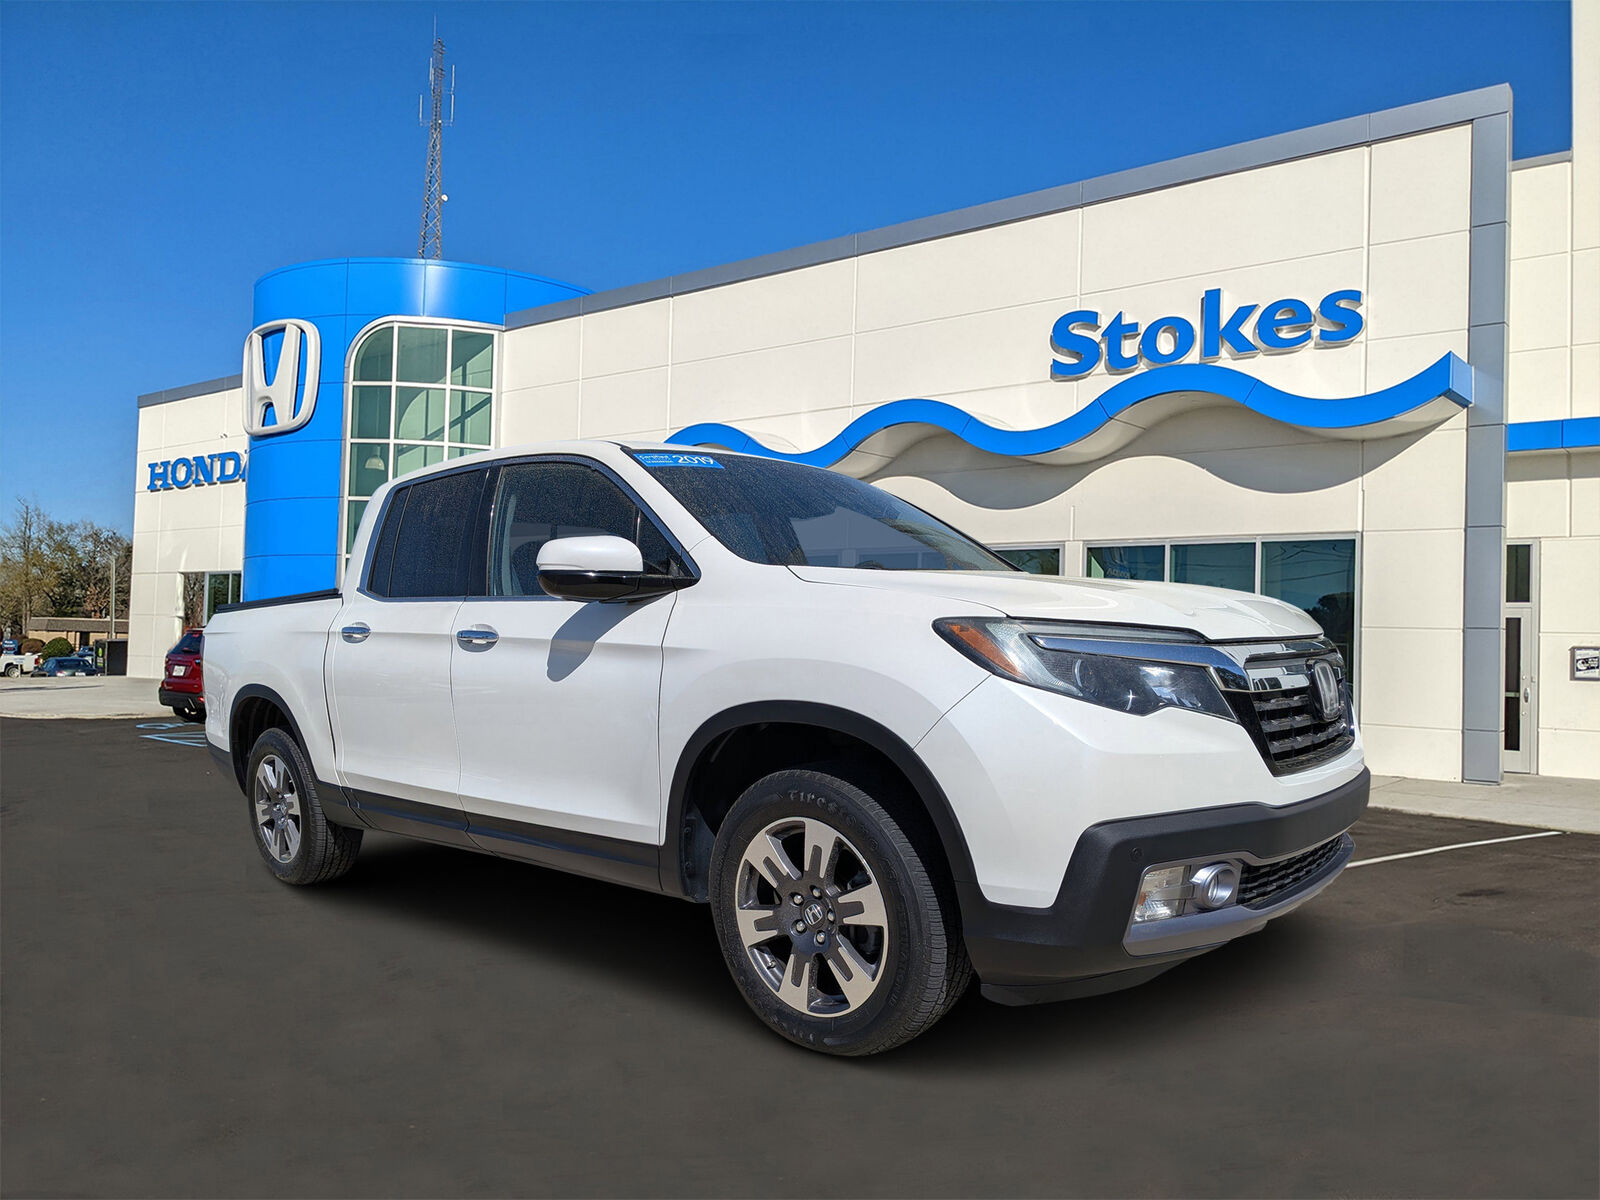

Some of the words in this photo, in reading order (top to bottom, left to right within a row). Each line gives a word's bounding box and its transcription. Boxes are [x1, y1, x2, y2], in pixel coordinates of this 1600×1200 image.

[1050, 288, 1364, 380] Stokes
[147, 450, 247, 491] HOND
[672, 455, 714, 465] 2019
